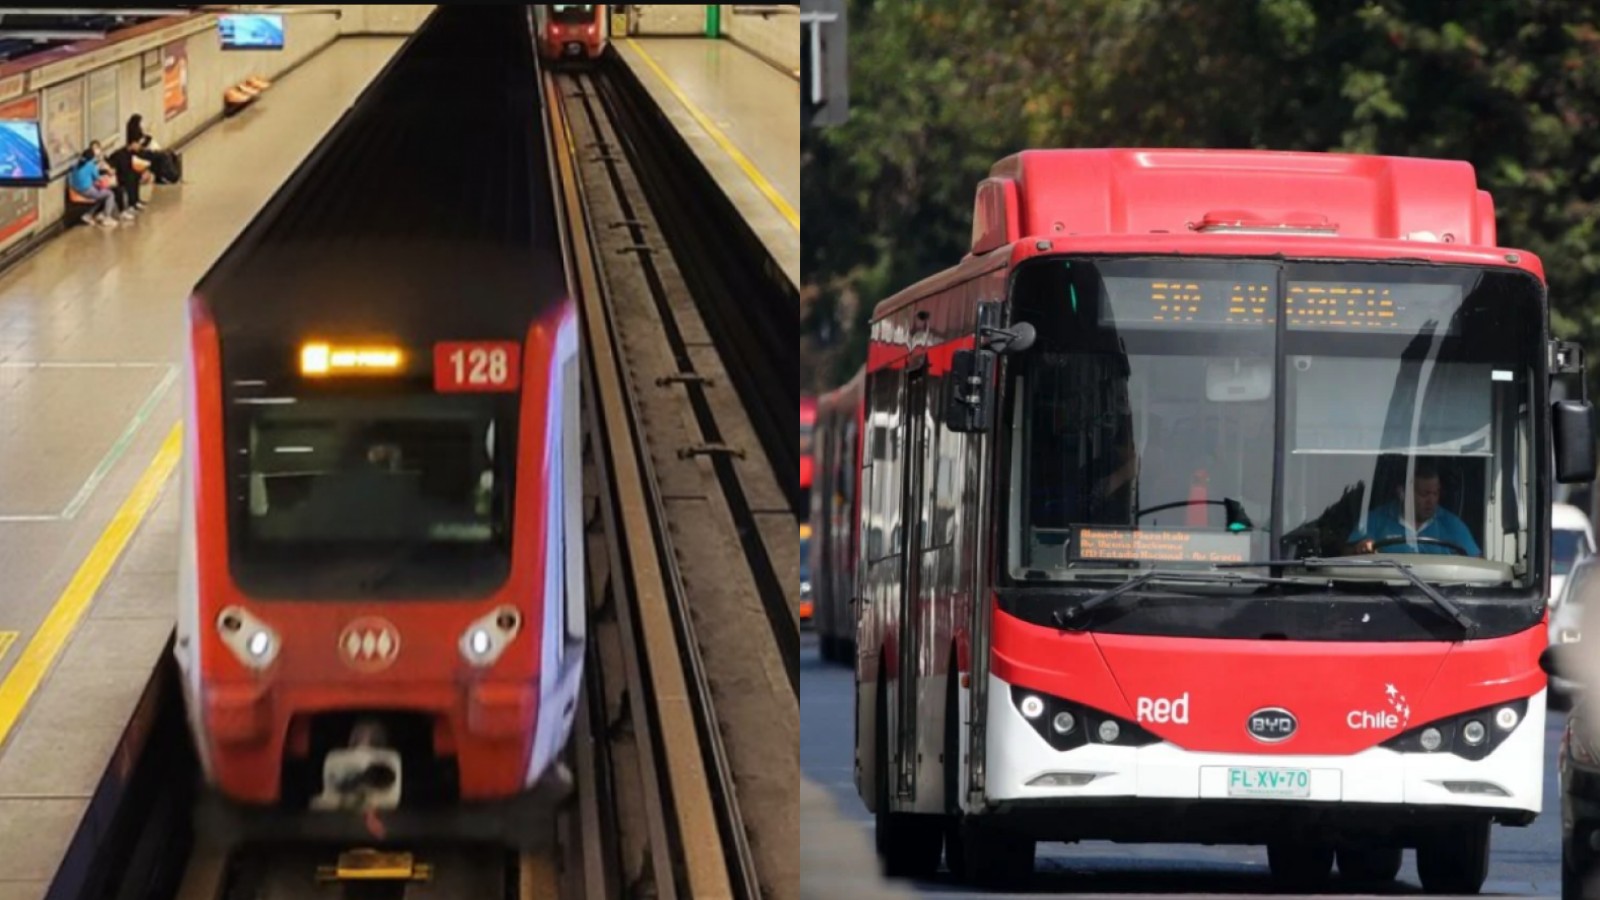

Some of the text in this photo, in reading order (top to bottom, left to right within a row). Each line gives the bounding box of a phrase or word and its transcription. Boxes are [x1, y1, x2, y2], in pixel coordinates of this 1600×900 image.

[1286, 287, 1398, 326] GRECIA
[450, 348, 508, 384] 128
[1137, 692, 1189, 724] Red
[1347, 709, 1398, 729] Chile
[1252, 717, 1292, 732] BYD
